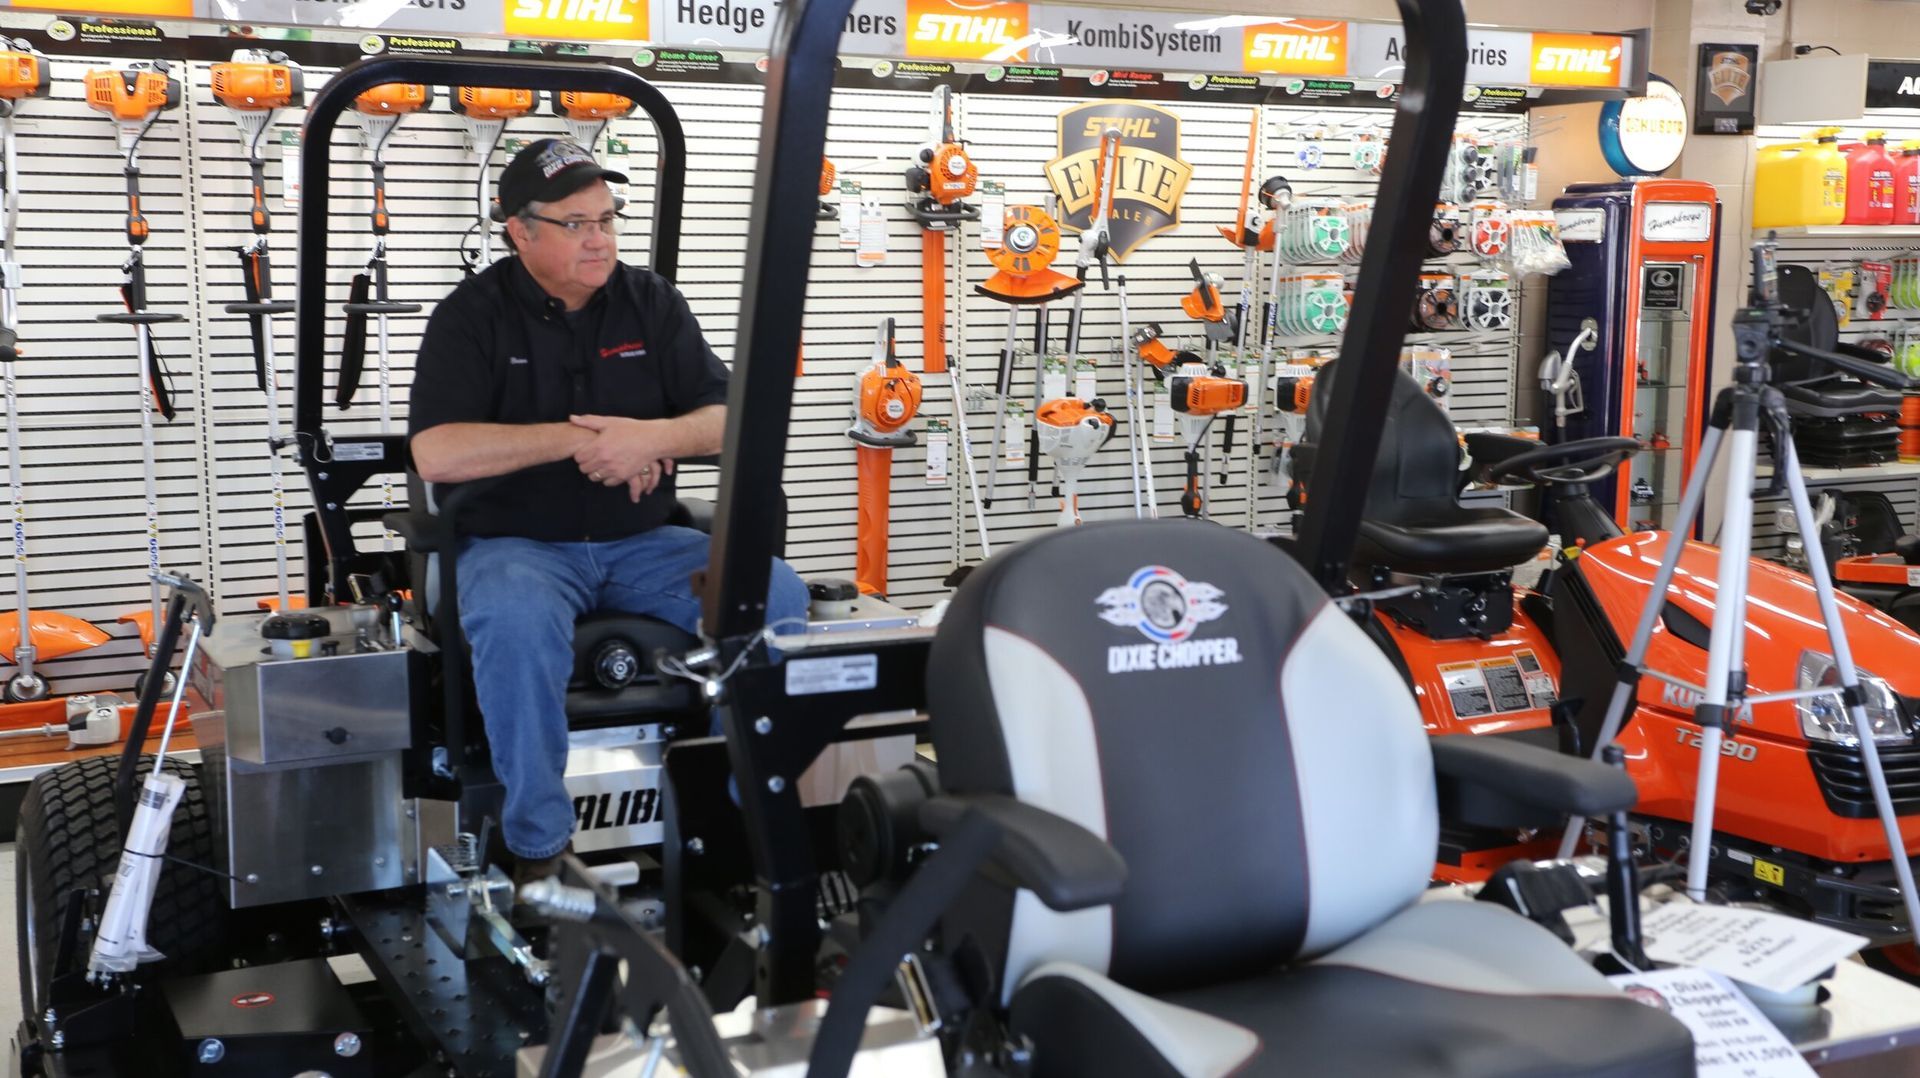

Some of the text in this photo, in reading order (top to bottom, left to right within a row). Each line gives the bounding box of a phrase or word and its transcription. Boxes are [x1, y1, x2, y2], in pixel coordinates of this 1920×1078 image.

[81, 23, 157, 37] Professional
[678, 0, 765, 34] Hedge
[914, 13, 1014, 46] STIHL
[389, 36, 457, 49] Professional
[1068, 20, 1222, 56] KombiSystem
[1250, 33, 1336, 61] STIHL
[897, 62, 951, 73] Professional
[1535, 46, 1612, 73] STIHL
[1211, 75, 1257, 85] Professional
[1108, 637, 1239, 674] DIXIE CHOPPER
[1676, 727, 1758, 762] T290
